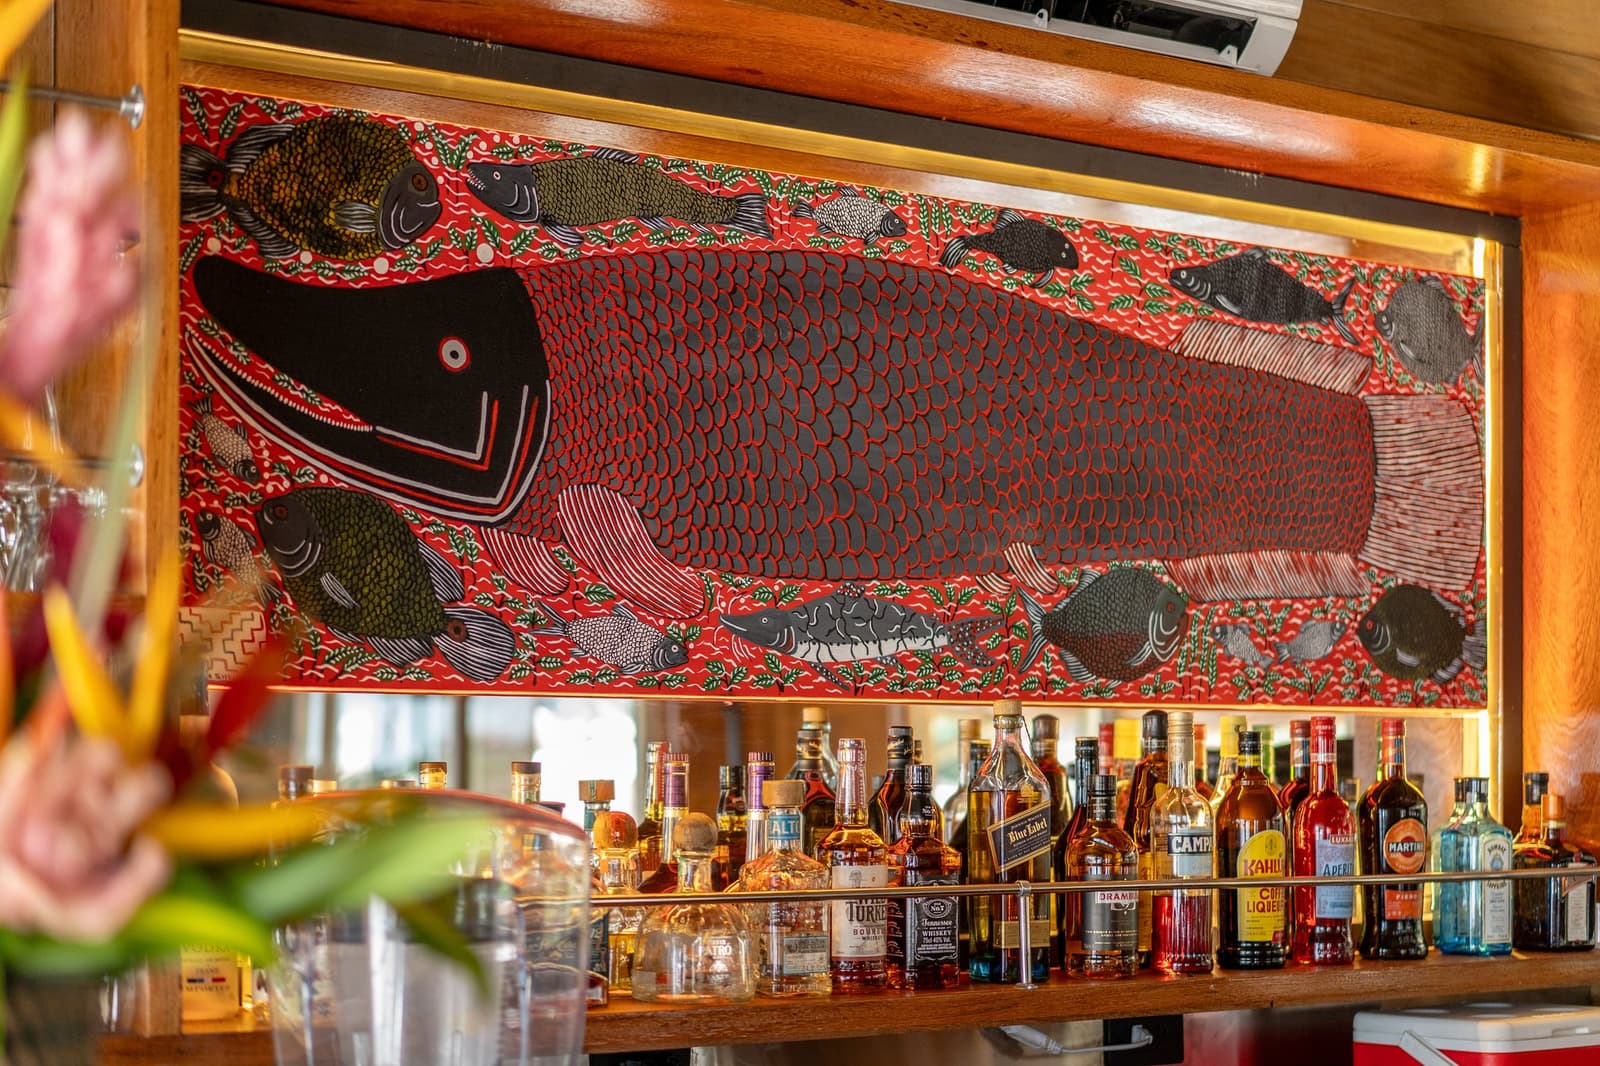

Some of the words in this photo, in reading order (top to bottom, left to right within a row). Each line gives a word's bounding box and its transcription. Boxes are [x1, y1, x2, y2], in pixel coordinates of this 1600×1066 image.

[1008, 829, 1027, 844] Blue
[1026, 817, 1047, 837] Label
[1389, 842, 1423, 853] MARTINI
[921, 918, 953, 927] Tennessee
